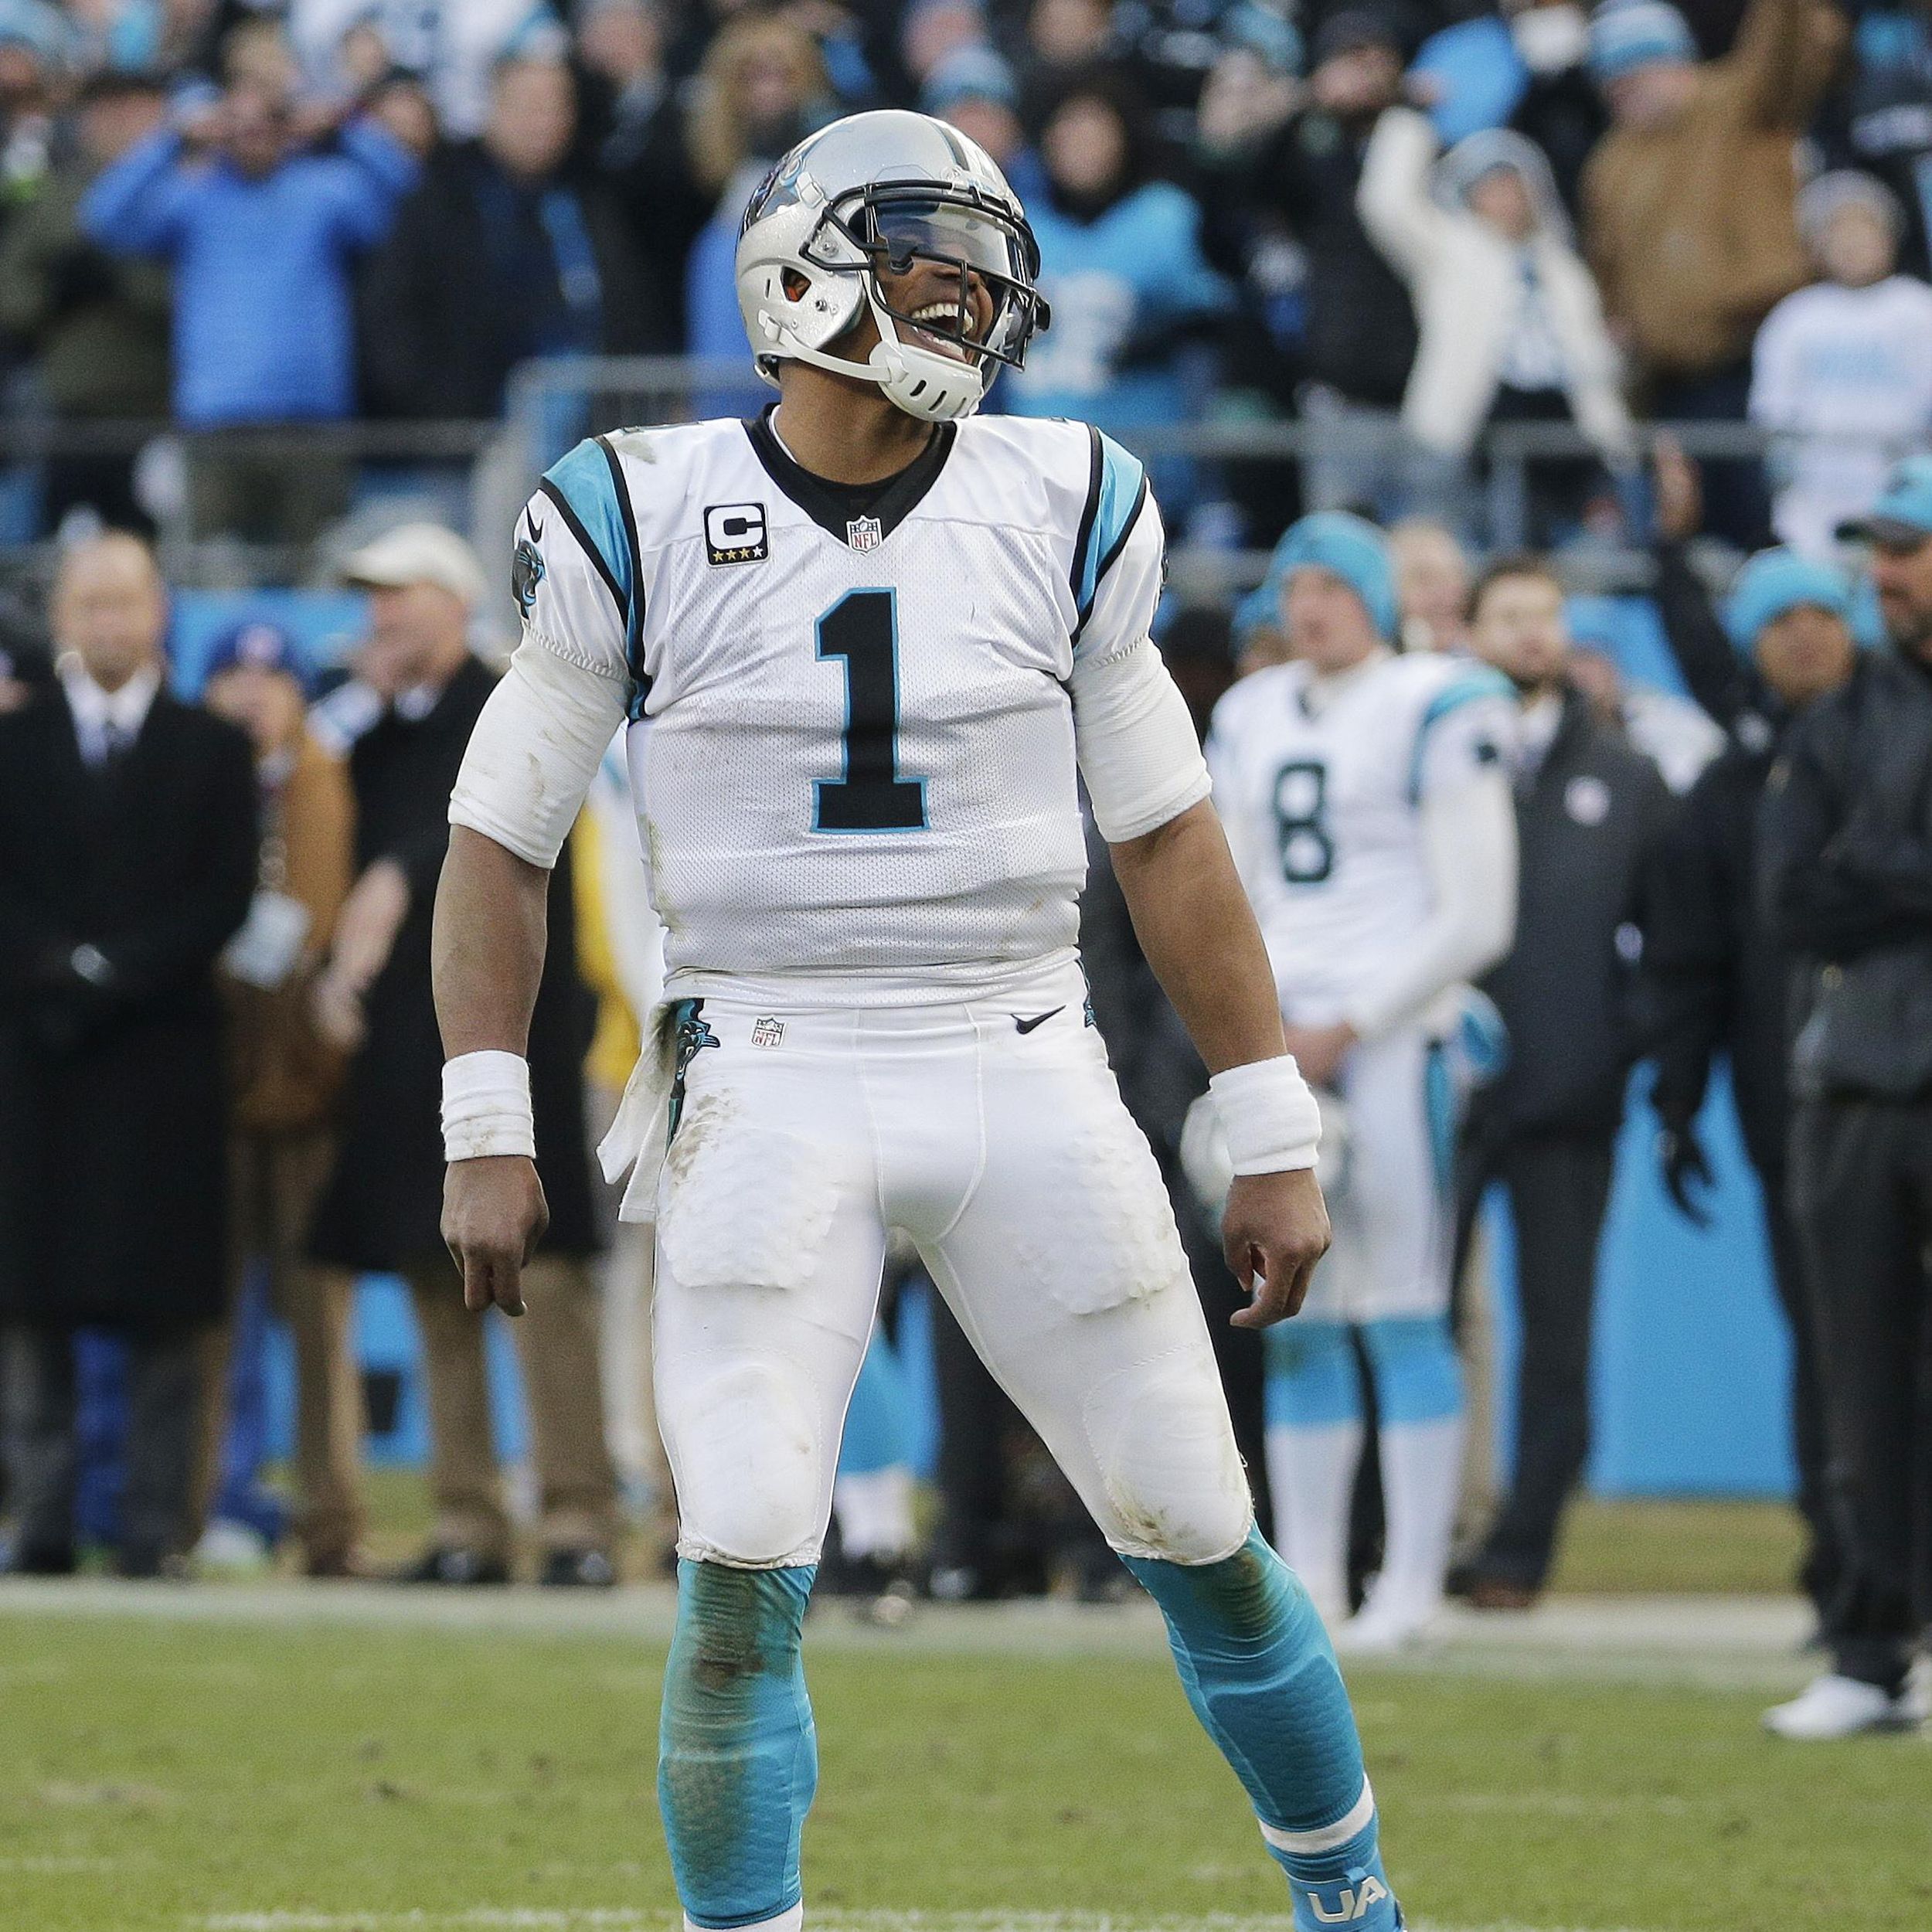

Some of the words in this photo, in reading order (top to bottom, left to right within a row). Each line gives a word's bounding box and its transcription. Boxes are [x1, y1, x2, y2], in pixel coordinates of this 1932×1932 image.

[708, 505, 764, 549] C
[853, 533, 877, 550] NFL
[810, 587, 930, 835] 1
[1274, 759, 1333, 883] 8
[754, 1030, 777, 1046] NFL
[1308, 1876, 1389, 1923] UA
